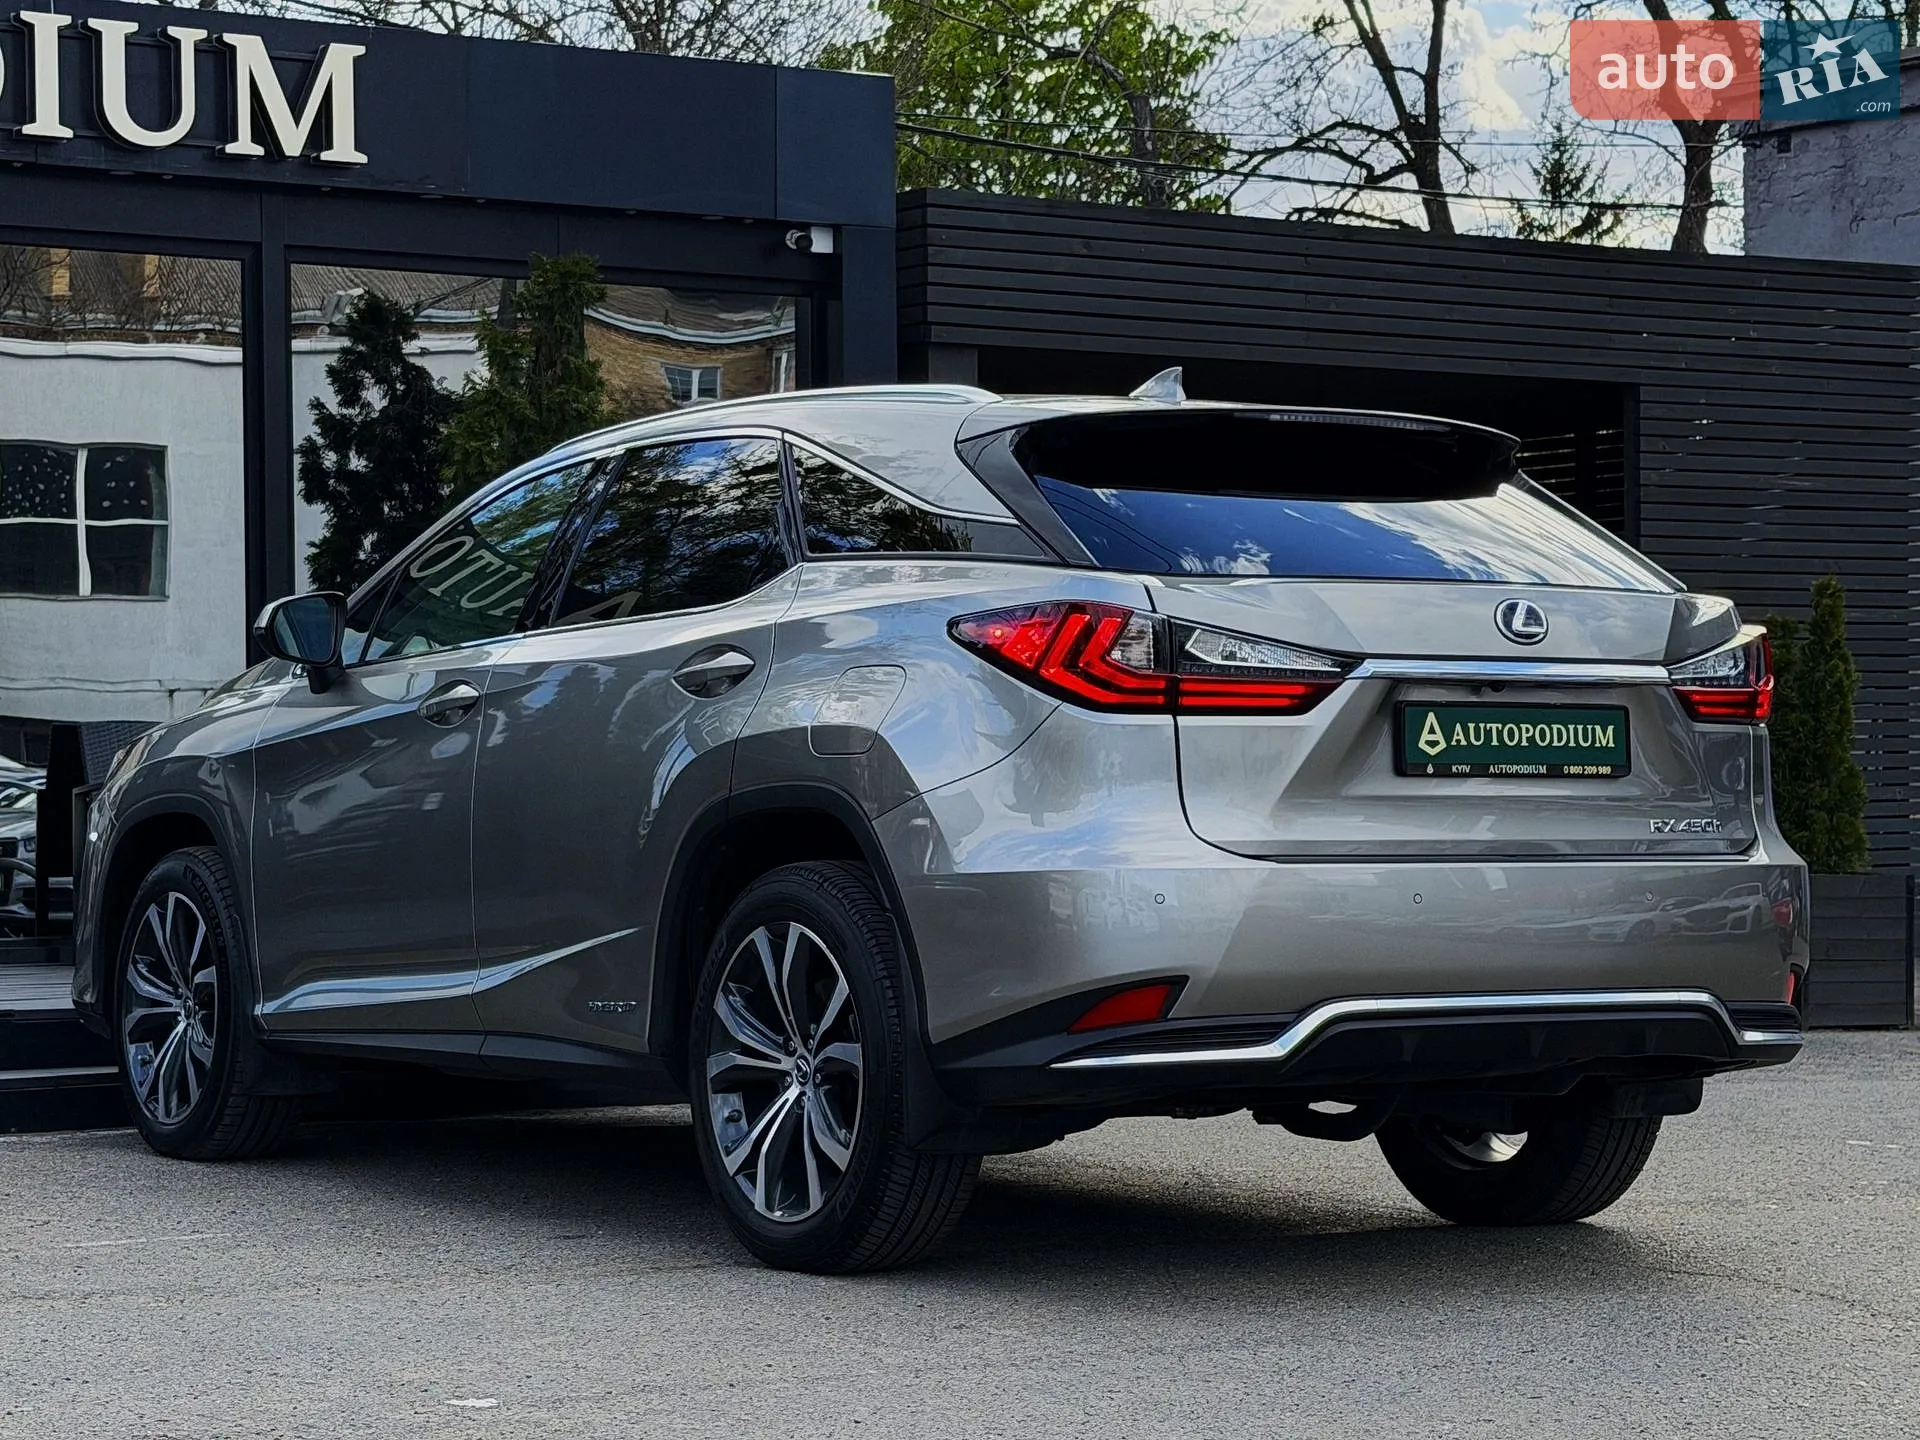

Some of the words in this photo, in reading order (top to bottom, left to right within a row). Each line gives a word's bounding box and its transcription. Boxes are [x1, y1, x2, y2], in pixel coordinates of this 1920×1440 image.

[0, 10, 369, 164] IUM
[1451, 722, 1615, 748] AUTOPODIUM
[1452, 764, 1471, 774] KYIV
[1488, 764, 1547, 774] AUTOPODIUM
[1584, 765, 1597, 774] 209
